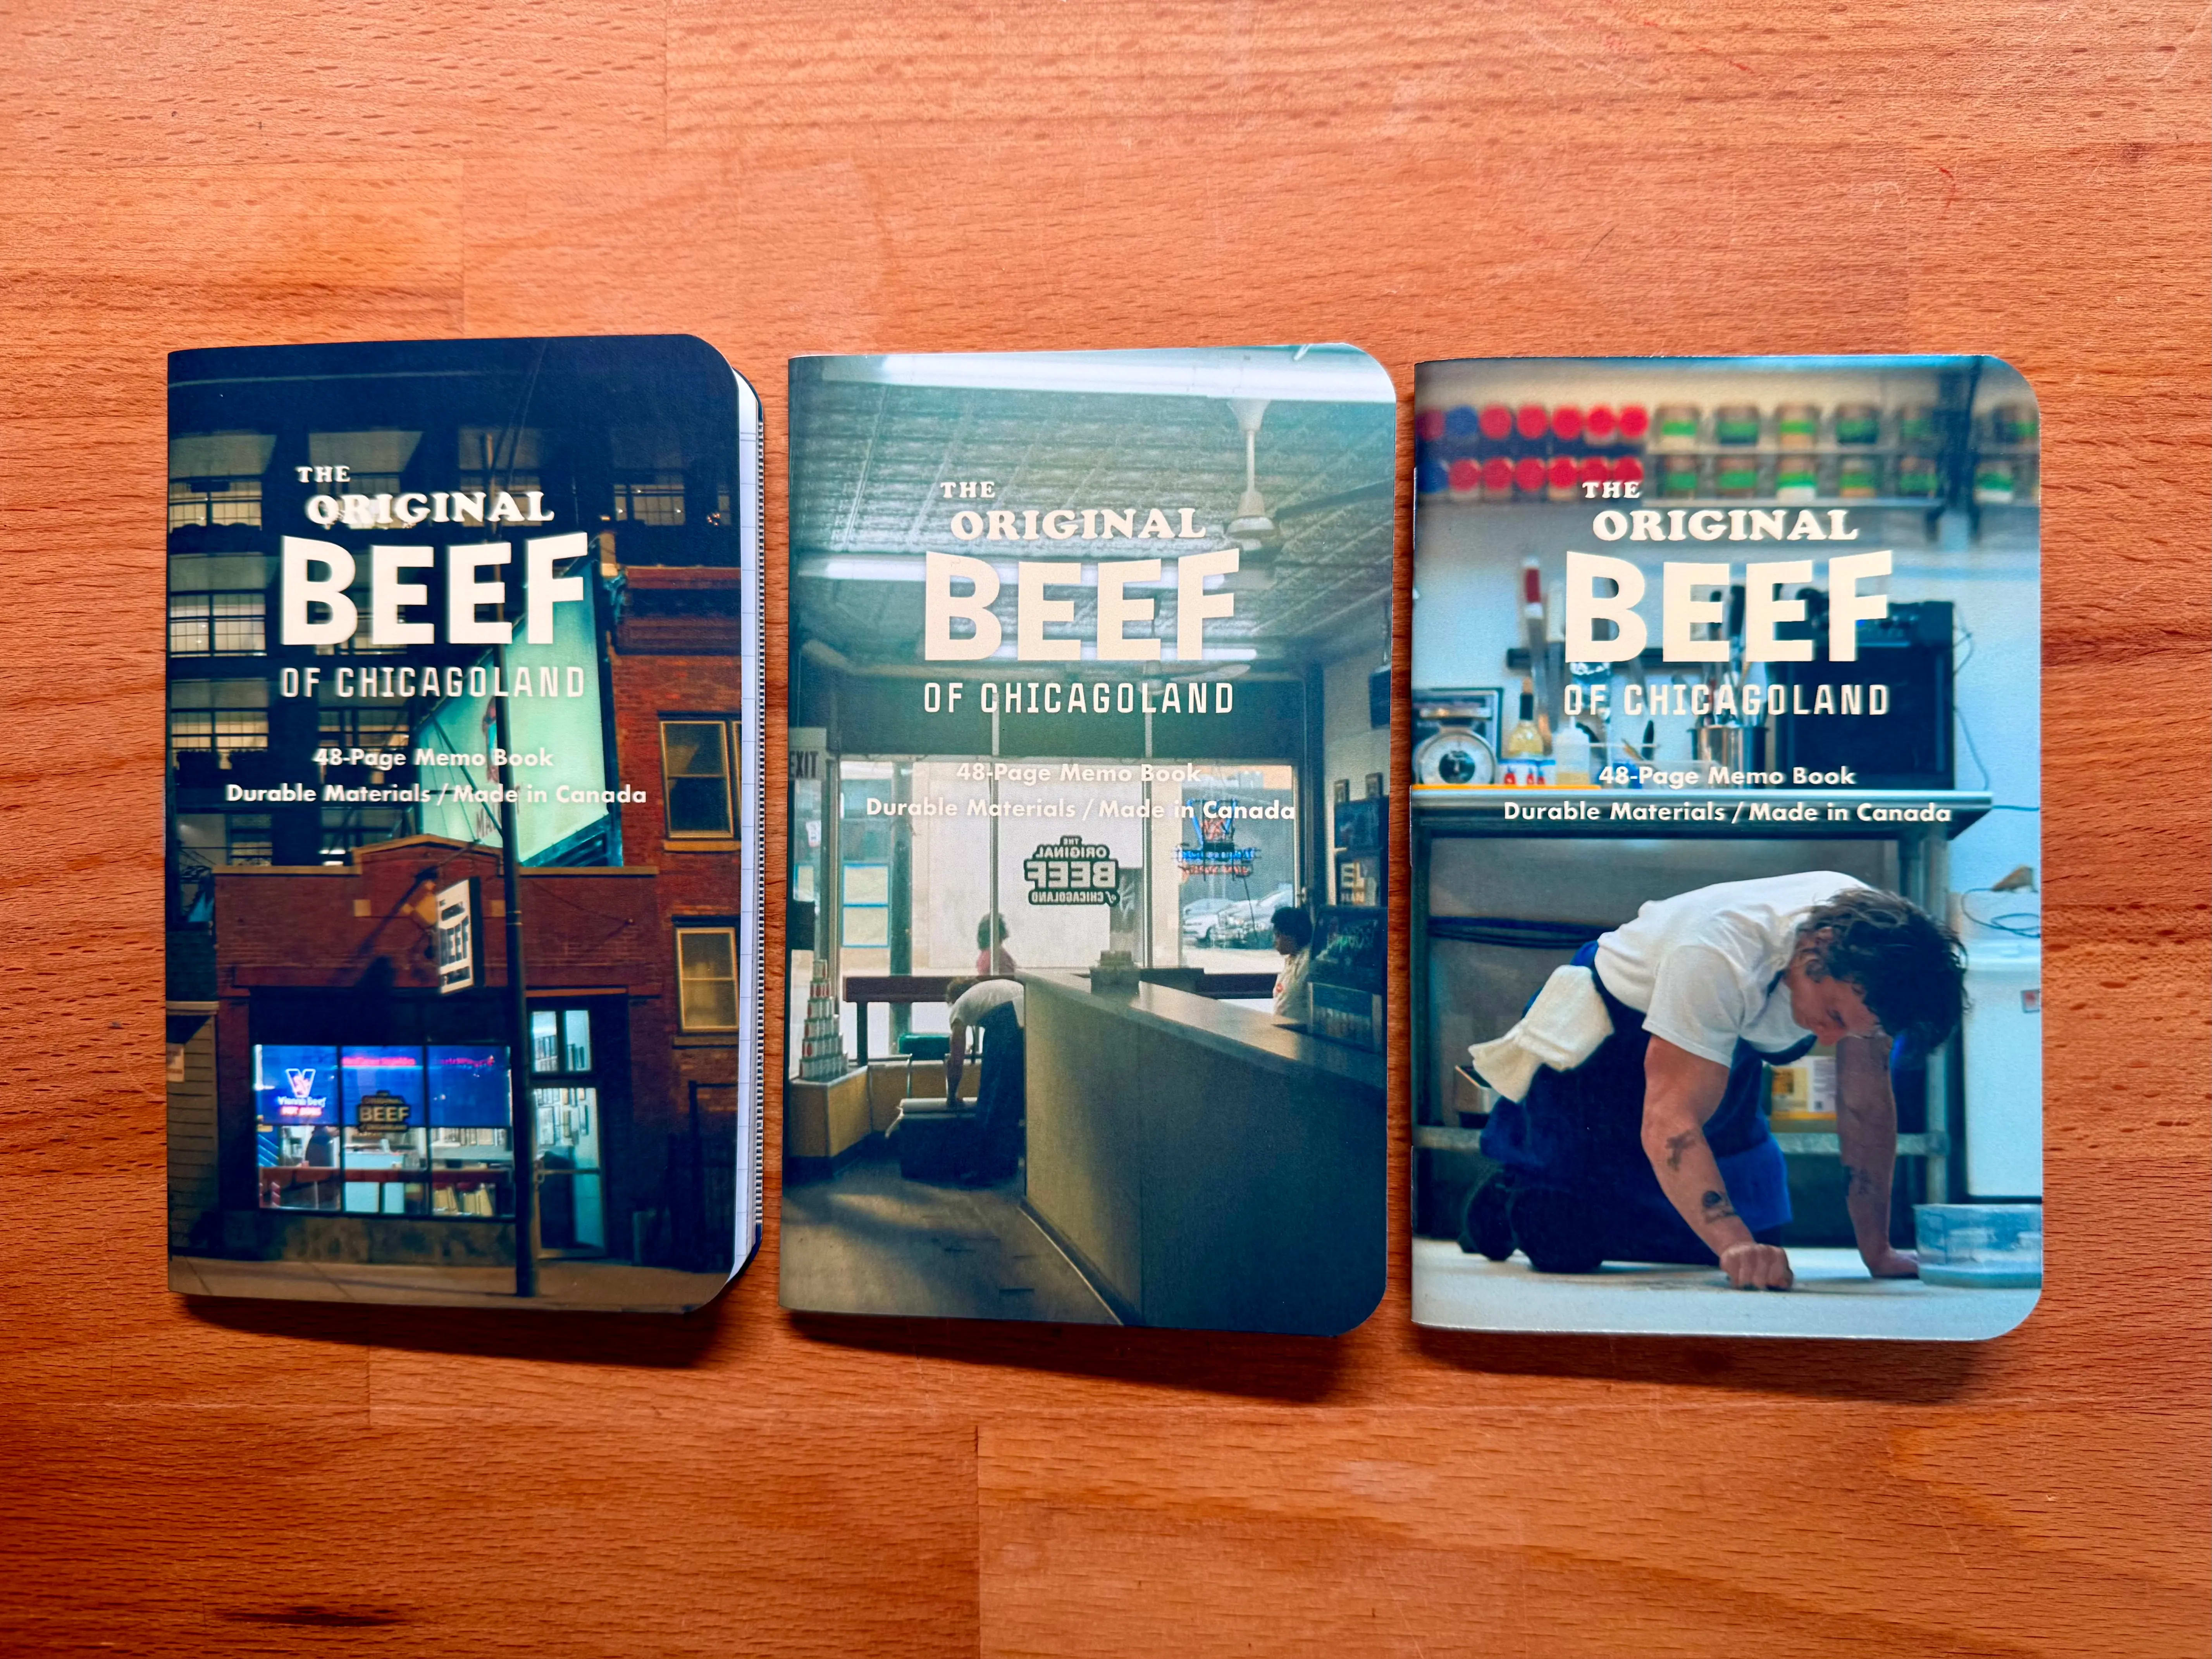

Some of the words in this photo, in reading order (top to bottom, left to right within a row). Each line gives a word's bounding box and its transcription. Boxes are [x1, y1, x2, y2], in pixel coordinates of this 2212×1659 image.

[298, 466, 350, 483] THE
[941, 482, 995, 497] THE
[1582, 482, 1640, 498] THE
[307, 492, 554, 526] ORIGINAL
[950, 508, 1206, 539] ORIGINAL
[1593, 509, 1858, 541] ORIGINAL
[281, 532, 587, 645] BEEF
[925, 548, 1239, 661] BEEF
[1565, 550, 1892, 662] BEEF
[281, 668, 320, 697] OF
[336, 666, 584, 697] CHICAGOLAND
[924, 683, 962, 713] OF
[981, 683, 1233, 713] CHICAGOLAND
[1564, 685, 1605, 715] OF
[1624, 685, 1889, 715] CHICAGOLAND
[314, 748, 405, 771] 48-Page
[414, 749, 485, 766] Memo
[492, 748, 553, 766] Book
[956, 763, 1051, 786] 48-Page
[1060, 764, 1133, 781] Memo
[1141, 763, 1201, 782] Book
[1599, 766, 1698, 790] 48-Page
[1708, 767, 1783, 785] Memo
[1792, 767, 1856, 785] Book
[227, 784, 316, 803] Durable
[325, 784, 430, 803] Materials
[454, 783, 517, 803] Made
[526, 784, 546, 803] in
[556, 783, 646, 803] Canada
[866, 799, 957, 817] Durable
[967, 799, 1076, 817] Materials
[1099, 800, 1164, 819] Made
[1173, 801, 1194, 819] in
[1203, 800, 1295, 820] Canada
[1503, 802, 1600, 821] Durable
[1610, 802, 1725, 821] Materials
[1749, 802, 1818, 821] Made
[1827, 802, 1848, 821] in
[1857, 802, 1950, 821] Canada
[360, 1107, 410, 1122] BEEF
